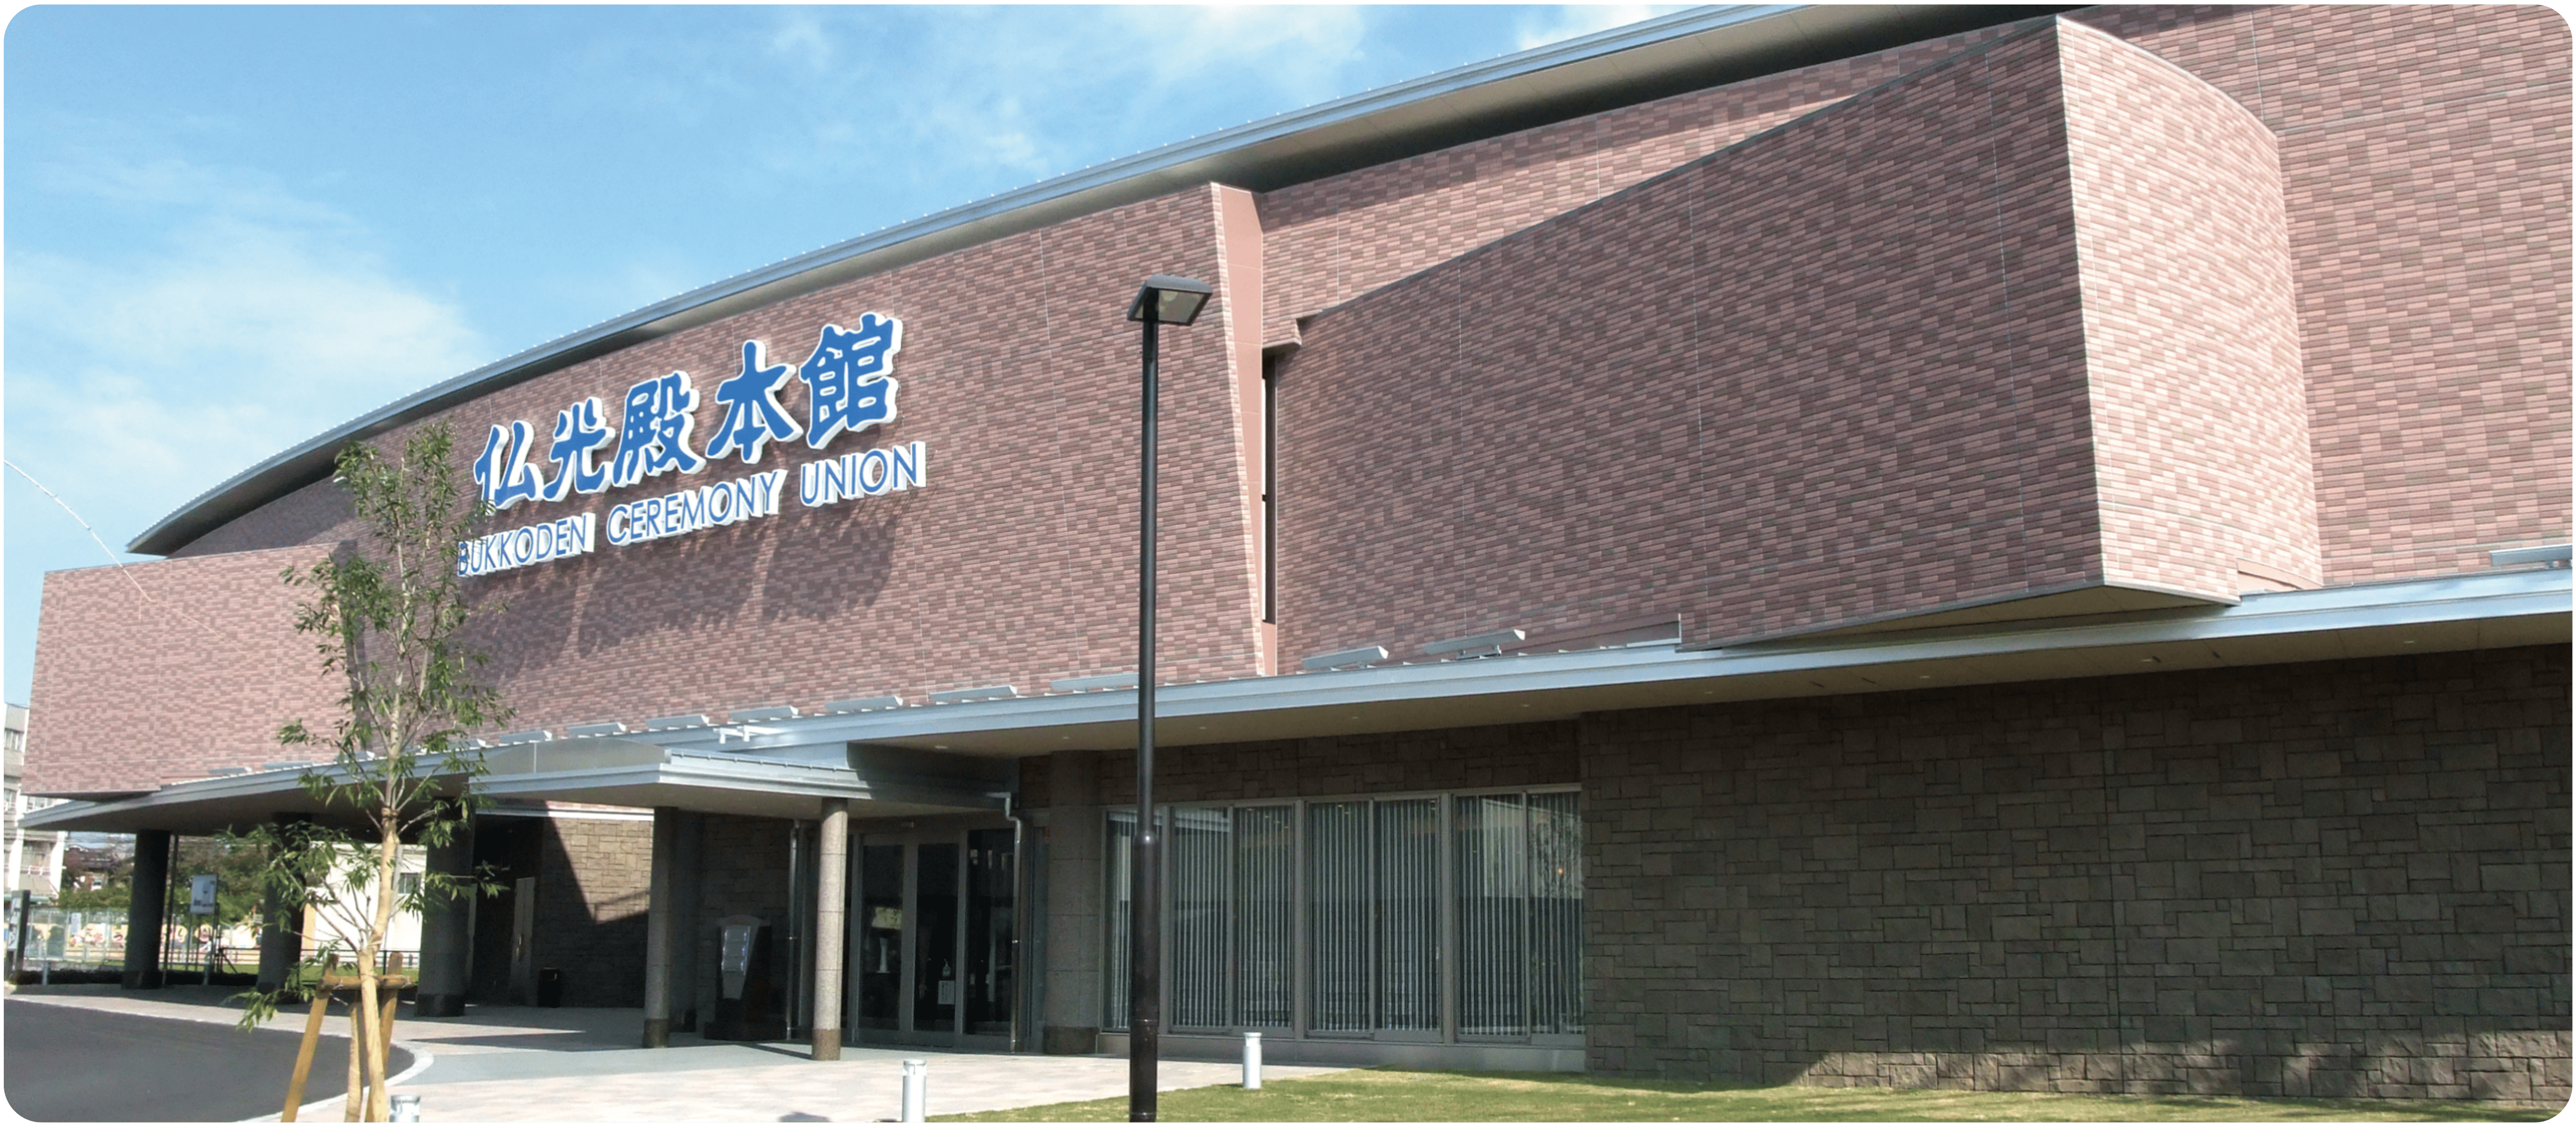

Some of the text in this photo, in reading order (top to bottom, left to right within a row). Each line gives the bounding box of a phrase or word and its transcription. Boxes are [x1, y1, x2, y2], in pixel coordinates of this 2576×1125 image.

[474, 312, 902, 515] 仏光殿本館
[457, 441, 925, 577] BUKKODEN CEREMONY UNION
